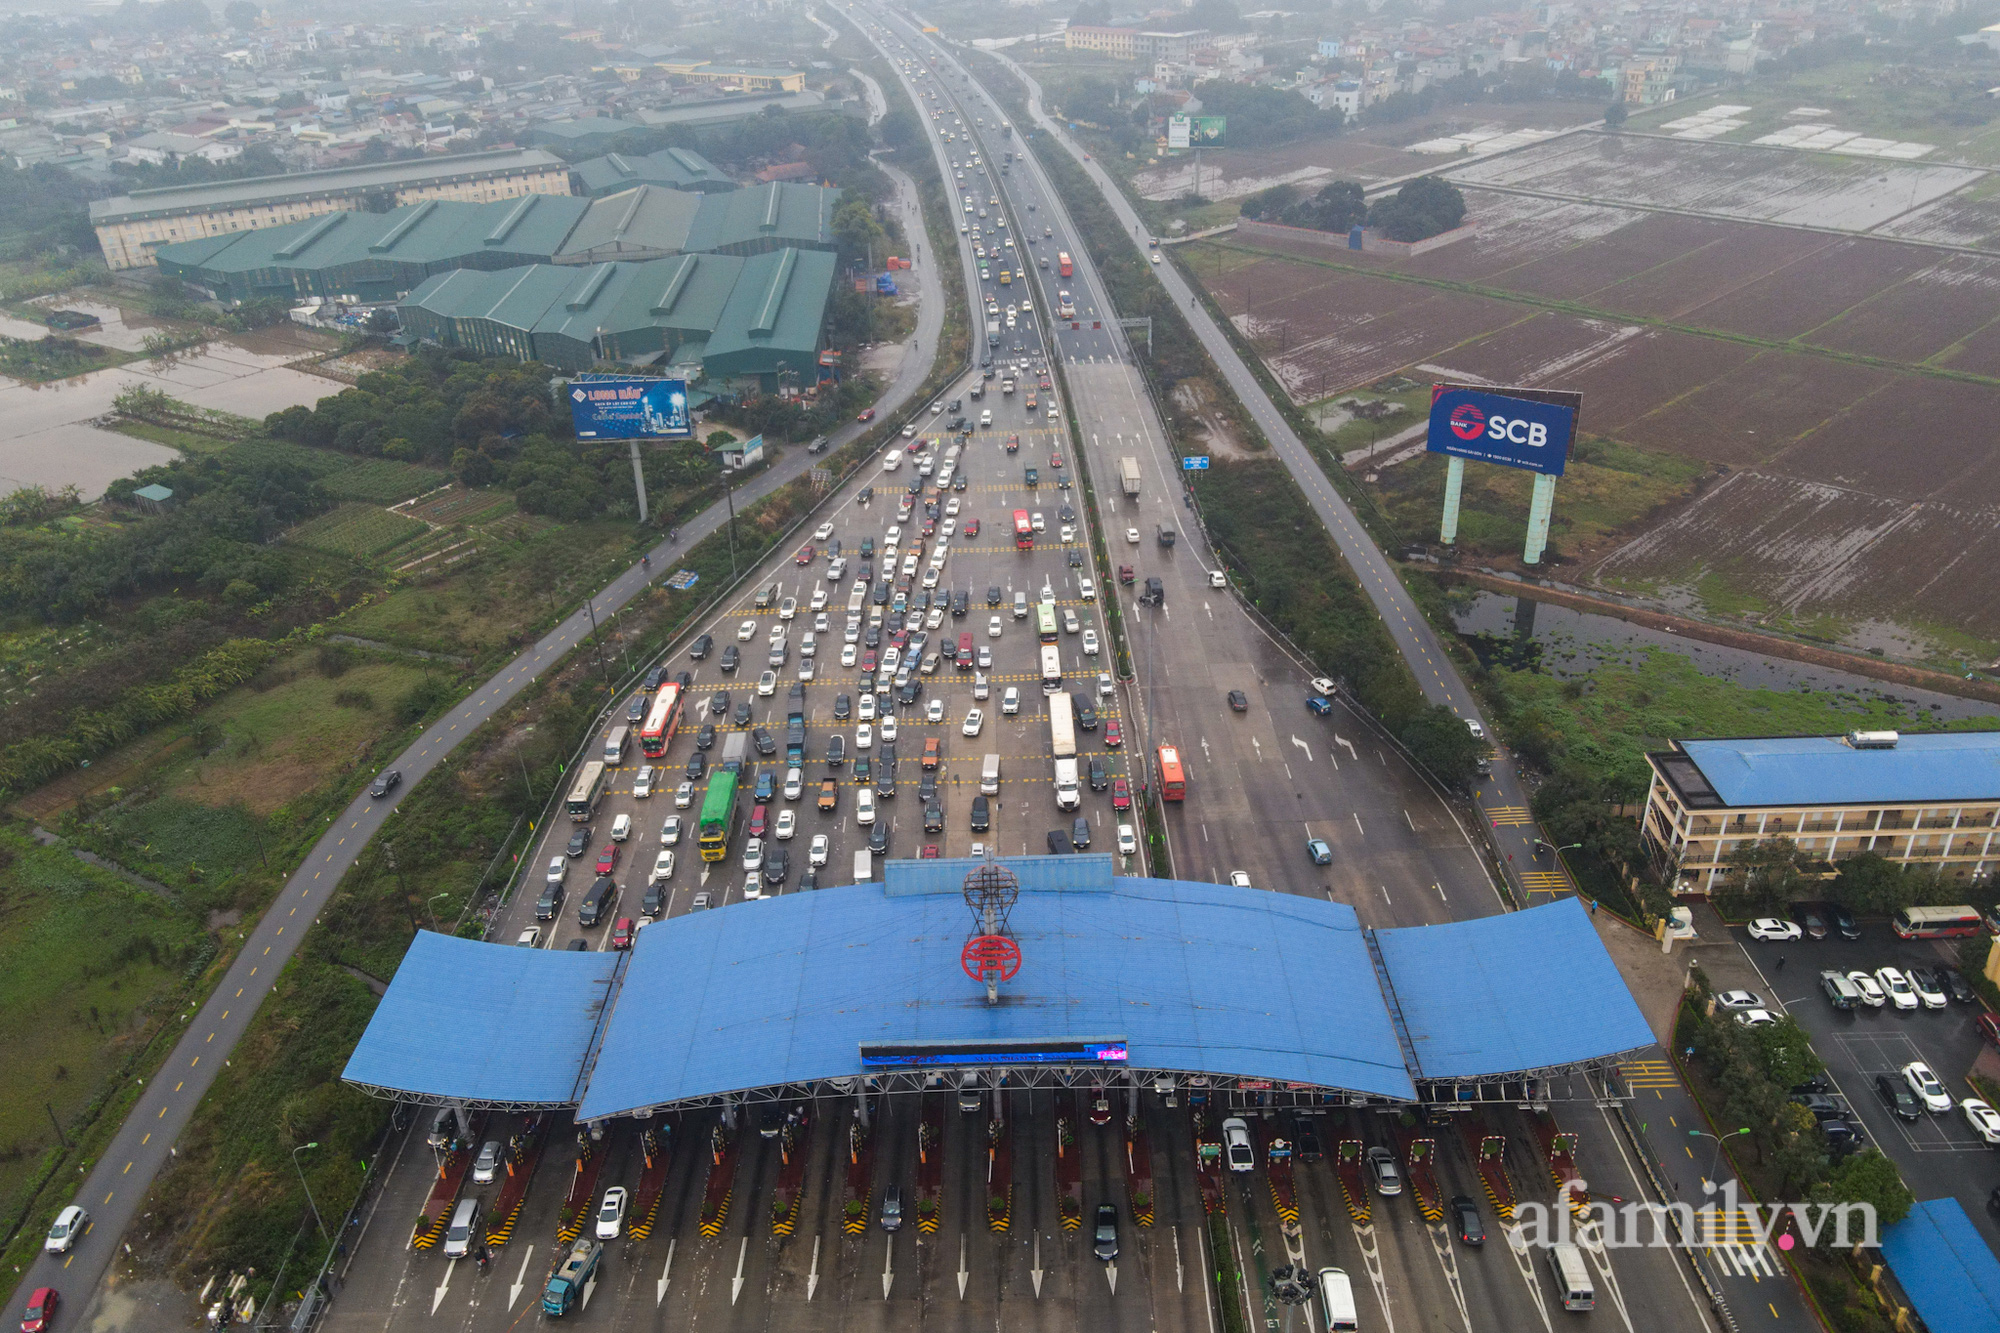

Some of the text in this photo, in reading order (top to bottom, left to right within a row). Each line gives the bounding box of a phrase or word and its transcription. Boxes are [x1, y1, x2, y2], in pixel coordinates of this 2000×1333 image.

[588, 389, 617, 400] LONG
[1450, 420, 1467, 428] BANK
[1488, 415, 1547, 447] SCB
